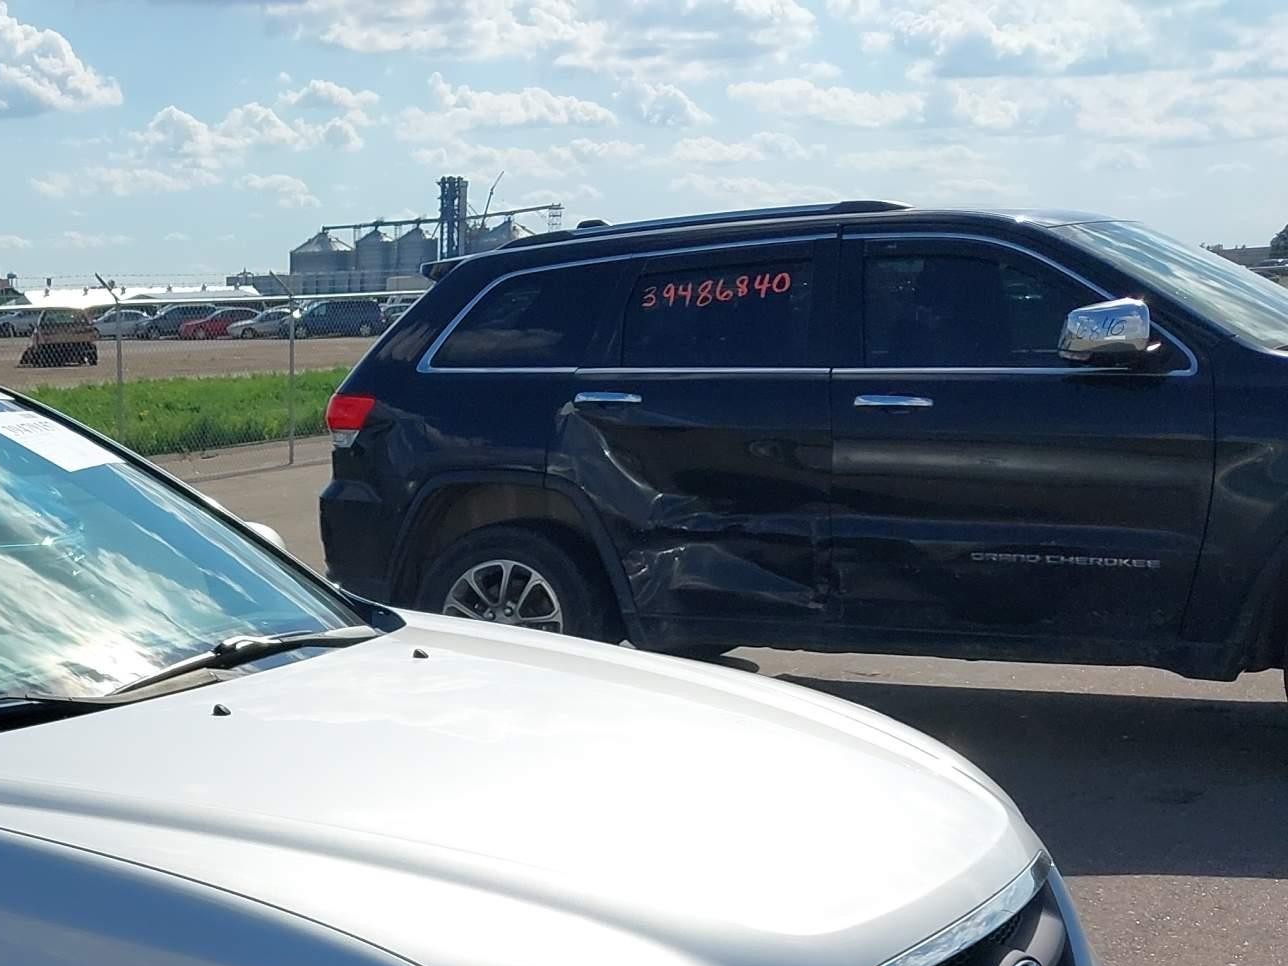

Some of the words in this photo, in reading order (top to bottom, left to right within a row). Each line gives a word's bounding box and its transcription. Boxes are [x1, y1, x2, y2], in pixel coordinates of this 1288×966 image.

[641, 272, 792, 308] 39486840
[970, 551, 1040, 564] GRAND
[1045, 554, 1162, 569] CHEROKEE
